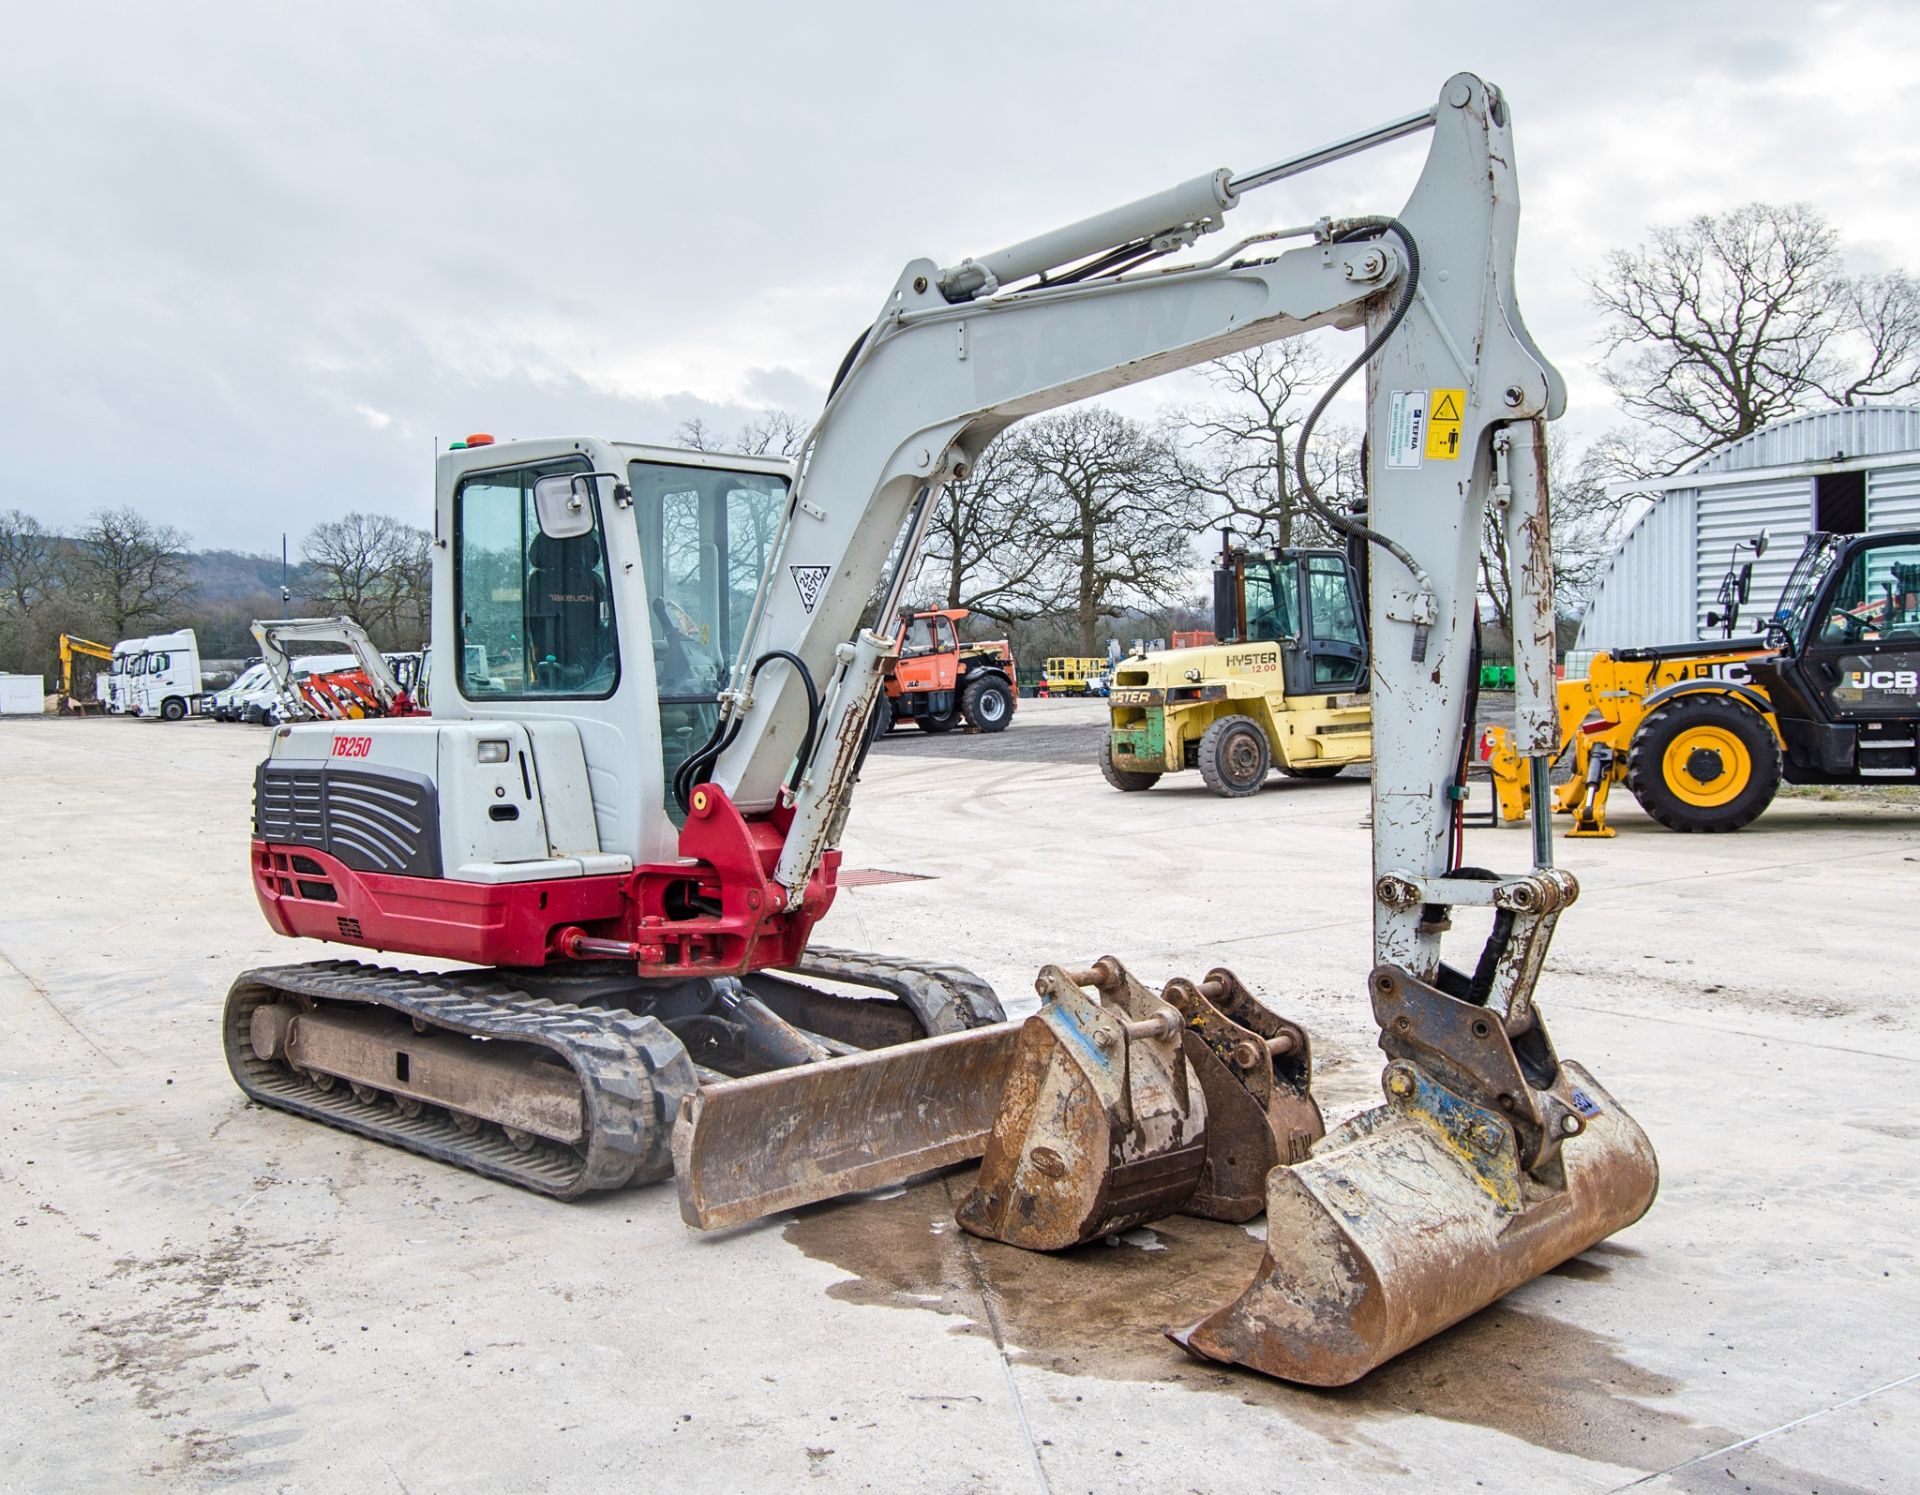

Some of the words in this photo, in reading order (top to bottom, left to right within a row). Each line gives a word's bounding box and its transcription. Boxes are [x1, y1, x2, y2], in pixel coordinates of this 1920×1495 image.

[1411, 420, 1420, 450] TEFRA
[799, 571, 811, 588] 24
[804, 569, 822, 602] AS7C
[1226, 652, 1277, 667] HYSTER
[1252, 664, 1277, 673] 12.00
[1852, 671, 1917, 689] JCB
[331, 736, 372, 758] TB250
